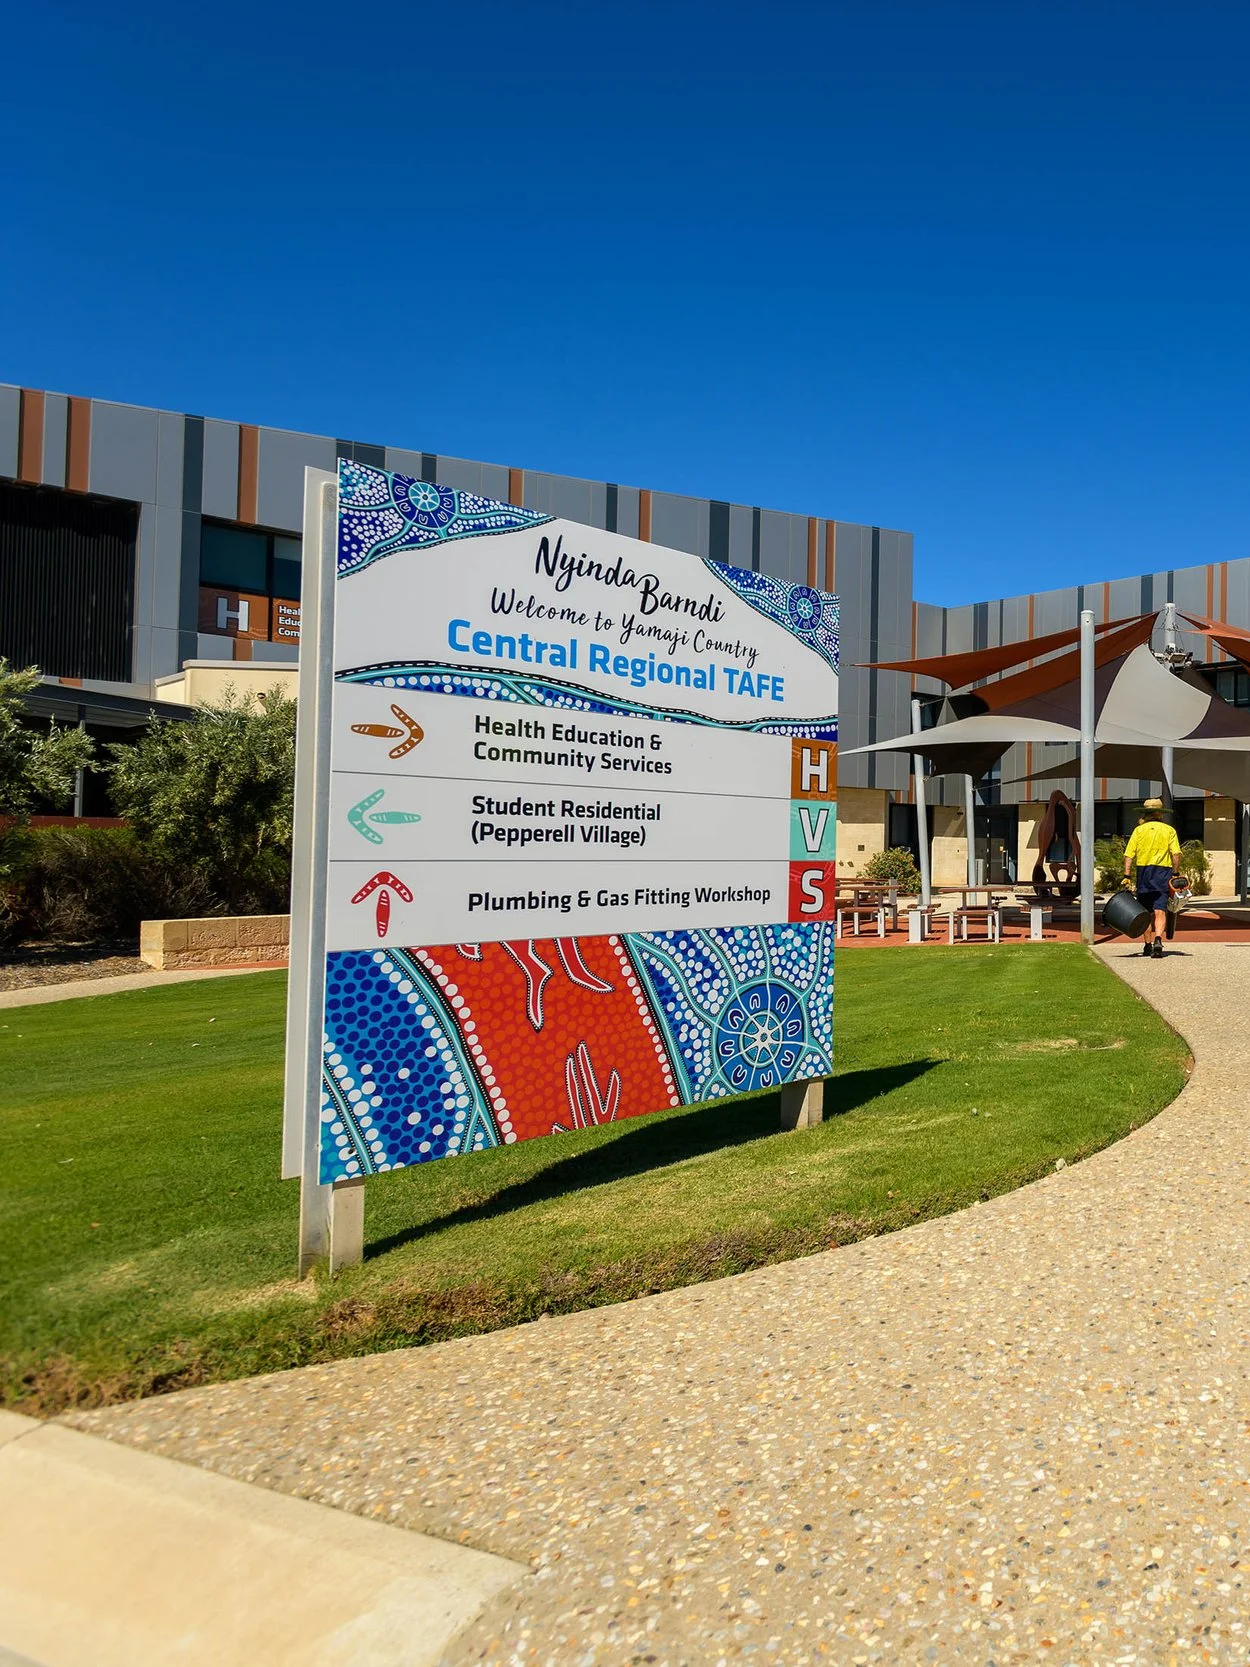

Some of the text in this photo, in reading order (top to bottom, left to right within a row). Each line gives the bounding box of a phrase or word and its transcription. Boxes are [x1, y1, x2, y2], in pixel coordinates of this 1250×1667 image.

[535, 534, 726, 623] Nyinda Barndi
[217, 597, 249, 632] H
[278, 605, 301, 616] Heal
[278, 616, 302, 627] Educ
[491, 587, 760, 669] Welcome to Yamaji Country
[278, 627, 301, 637] Com
[447, 618, 785, 703] Central Regional TAFE
[475, 714, 663, 751] Health Education &
[473, 741, 672, 775] Community Services
[801, 748, 828, 792] H
[471, 795, 661, 821] Student Residential
[471, 821, 646, 848] (Pepperell Village)
[799, 808, 829, 852] V
[468, 885, 771, 913] Plumbing & Gas Fitting Workshop
[800, 868, 824, 914] S
